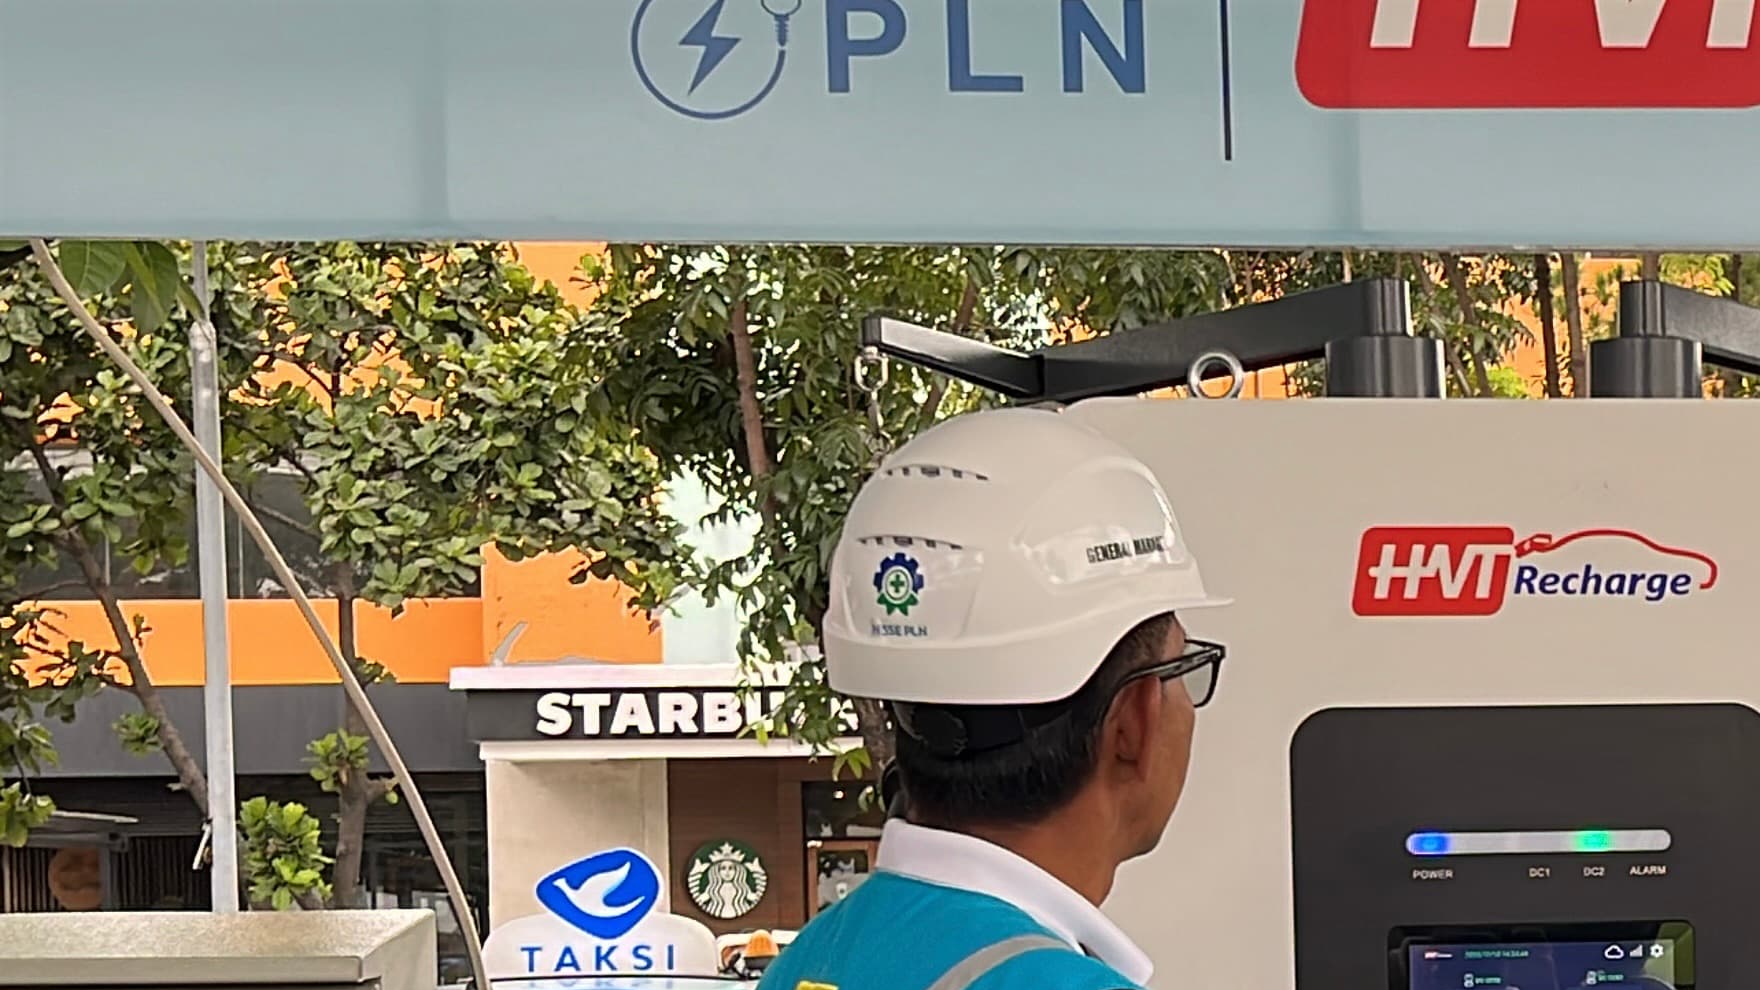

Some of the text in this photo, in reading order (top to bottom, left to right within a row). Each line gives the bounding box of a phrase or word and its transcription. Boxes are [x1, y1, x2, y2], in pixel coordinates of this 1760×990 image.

[825, 0, 1147, 94] PLN
[1368, 543, 1692, 601] HVT Recharge
[1412, 865, 1667, 880] POWER DC1 DC2 ALARM
[521, 943, 676, 974] TAKSI
